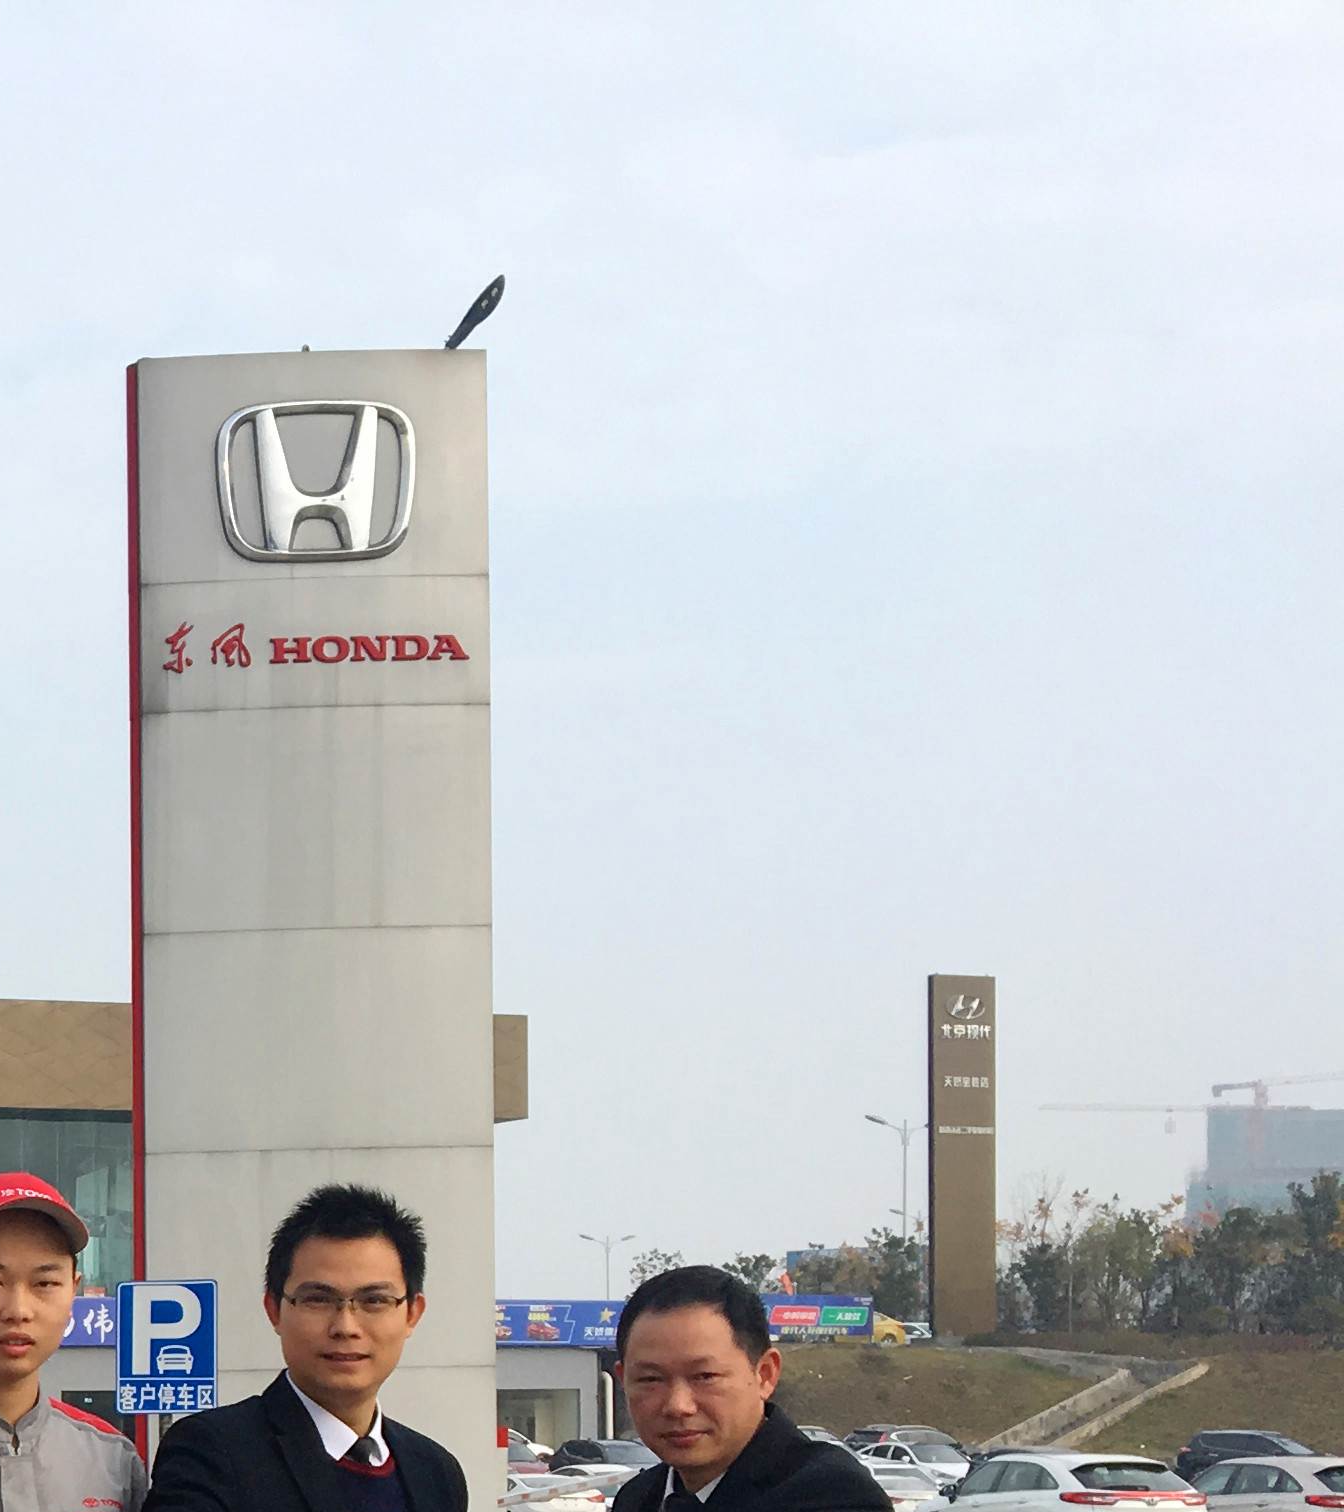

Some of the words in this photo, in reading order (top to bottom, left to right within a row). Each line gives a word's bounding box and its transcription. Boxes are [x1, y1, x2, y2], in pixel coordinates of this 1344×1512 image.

[163, 621, 252, 674] 东风
[268, 633, 470, 665] HONDA
[132, 1284, 202, 1376] P
[120, 1383, 214, 1410] 客户停车区
